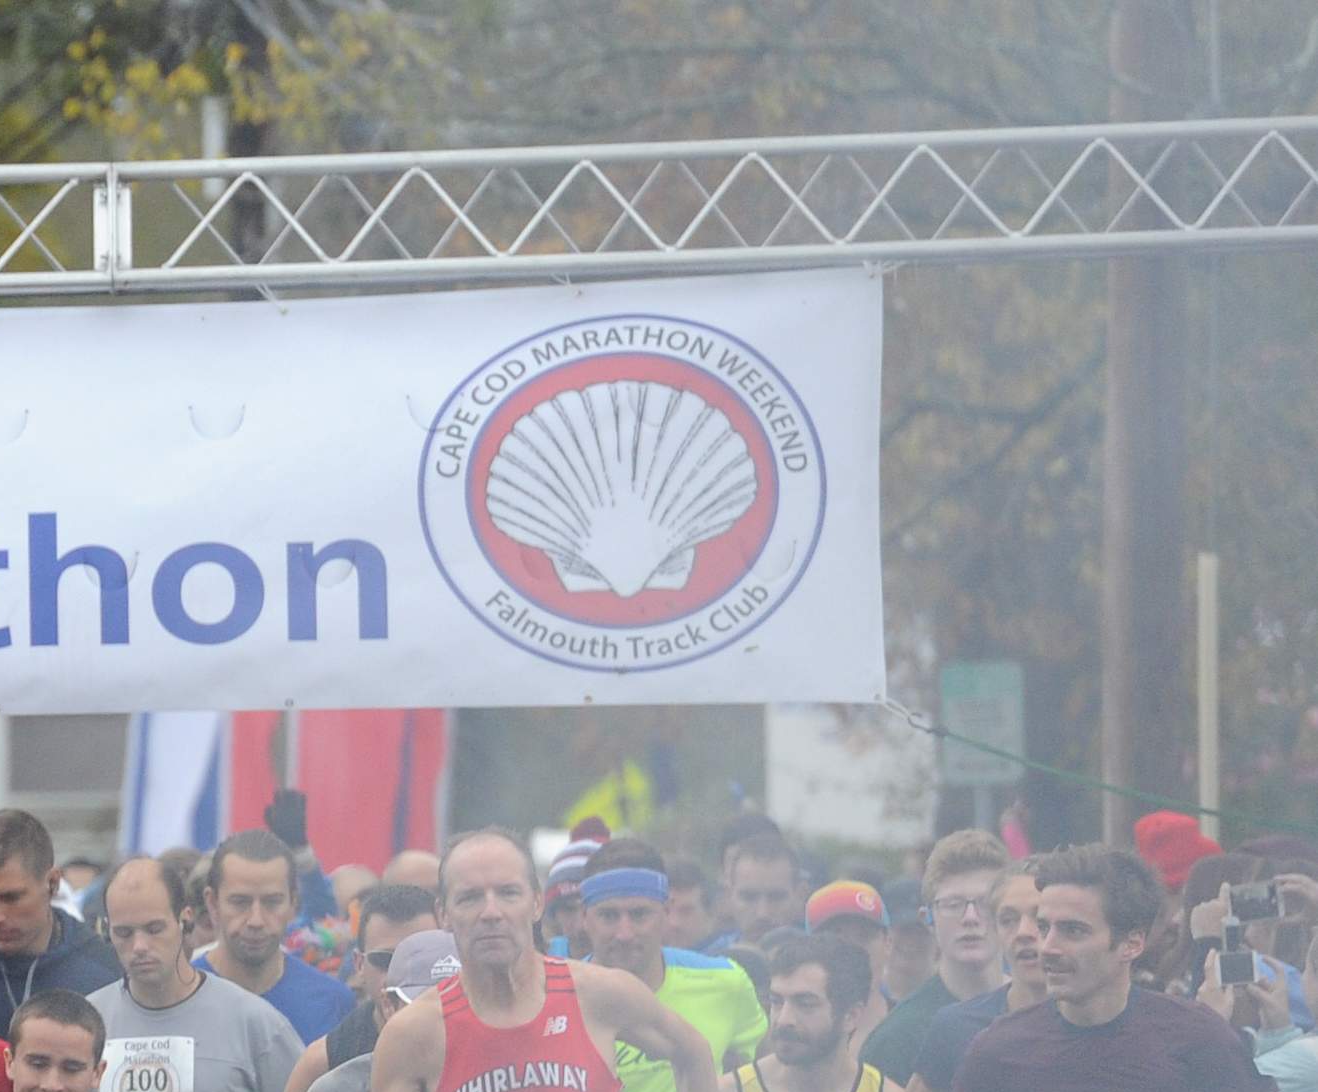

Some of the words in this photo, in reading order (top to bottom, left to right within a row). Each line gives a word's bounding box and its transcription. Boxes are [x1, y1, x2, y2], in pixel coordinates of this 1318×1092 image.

[435, 405, 481, 479] CAPE
[470, 358, 527, 407] COD
[531, 325, 713, 364] MARATHON
[715, 349, 808, 474] WEEKEND
[484, 587, 619, 659] Falmouth
[627, 624, 706, 659] Track
[709, 582, 769, 634] Club
[124, 1041, 149, 1051] Cape
[151, 1039, 170, 1050] Cod
[125, 1068, 168, 1092] 100
